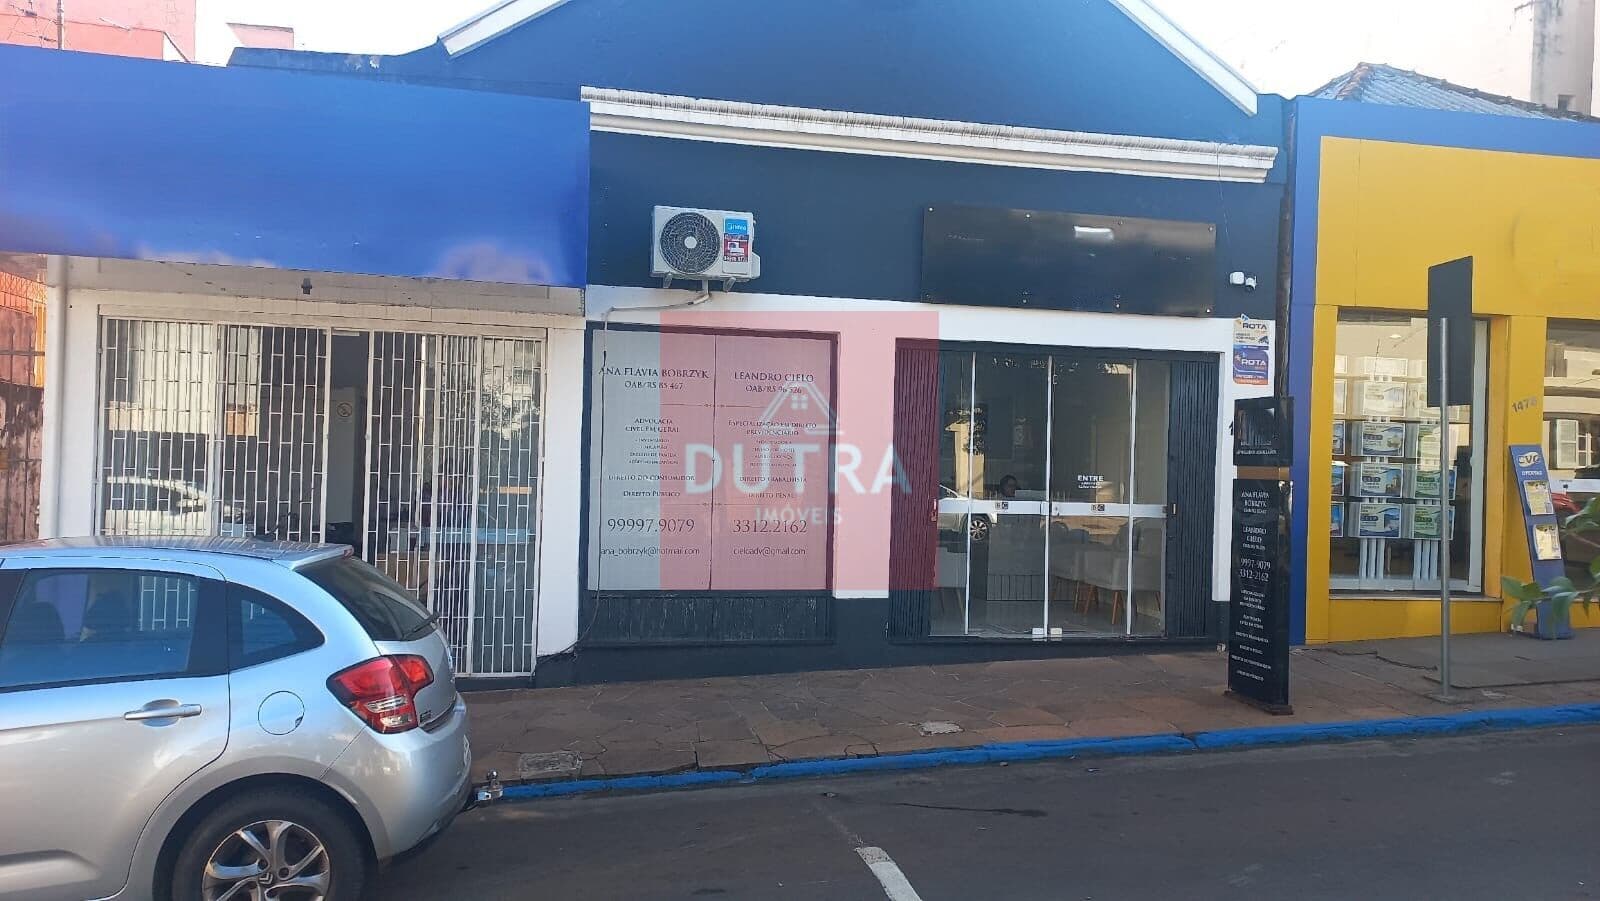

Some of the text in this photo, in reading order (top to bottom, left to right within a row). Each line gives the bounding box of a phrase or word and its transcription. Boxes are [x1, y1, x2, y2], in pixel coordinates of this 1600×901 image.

[1242, 322, 1267, 330] ROTA
[599, 367, 621, 376] ANA
[661, 368, 709, 379] BOBRZYK
[734, 371, 814, 383] LEANDRO CIELO
[745, 384, 776, 393] OAB/RS
[1518, 453, 1541, 465] CVC
[1077, 474, 1104, 482] ENTRE
[607, 518, 695, 533] 99997.9079
[733, 519, 807, 533] 3312.2162
[1242, 526, 1267, 535] LEANDRO
[733, 546, 806, 557] cieloadv@gmail.com
[1240, 558, 1271, 570] 9997-9079
[1239, 568, 1269, 582] 3312-2162
